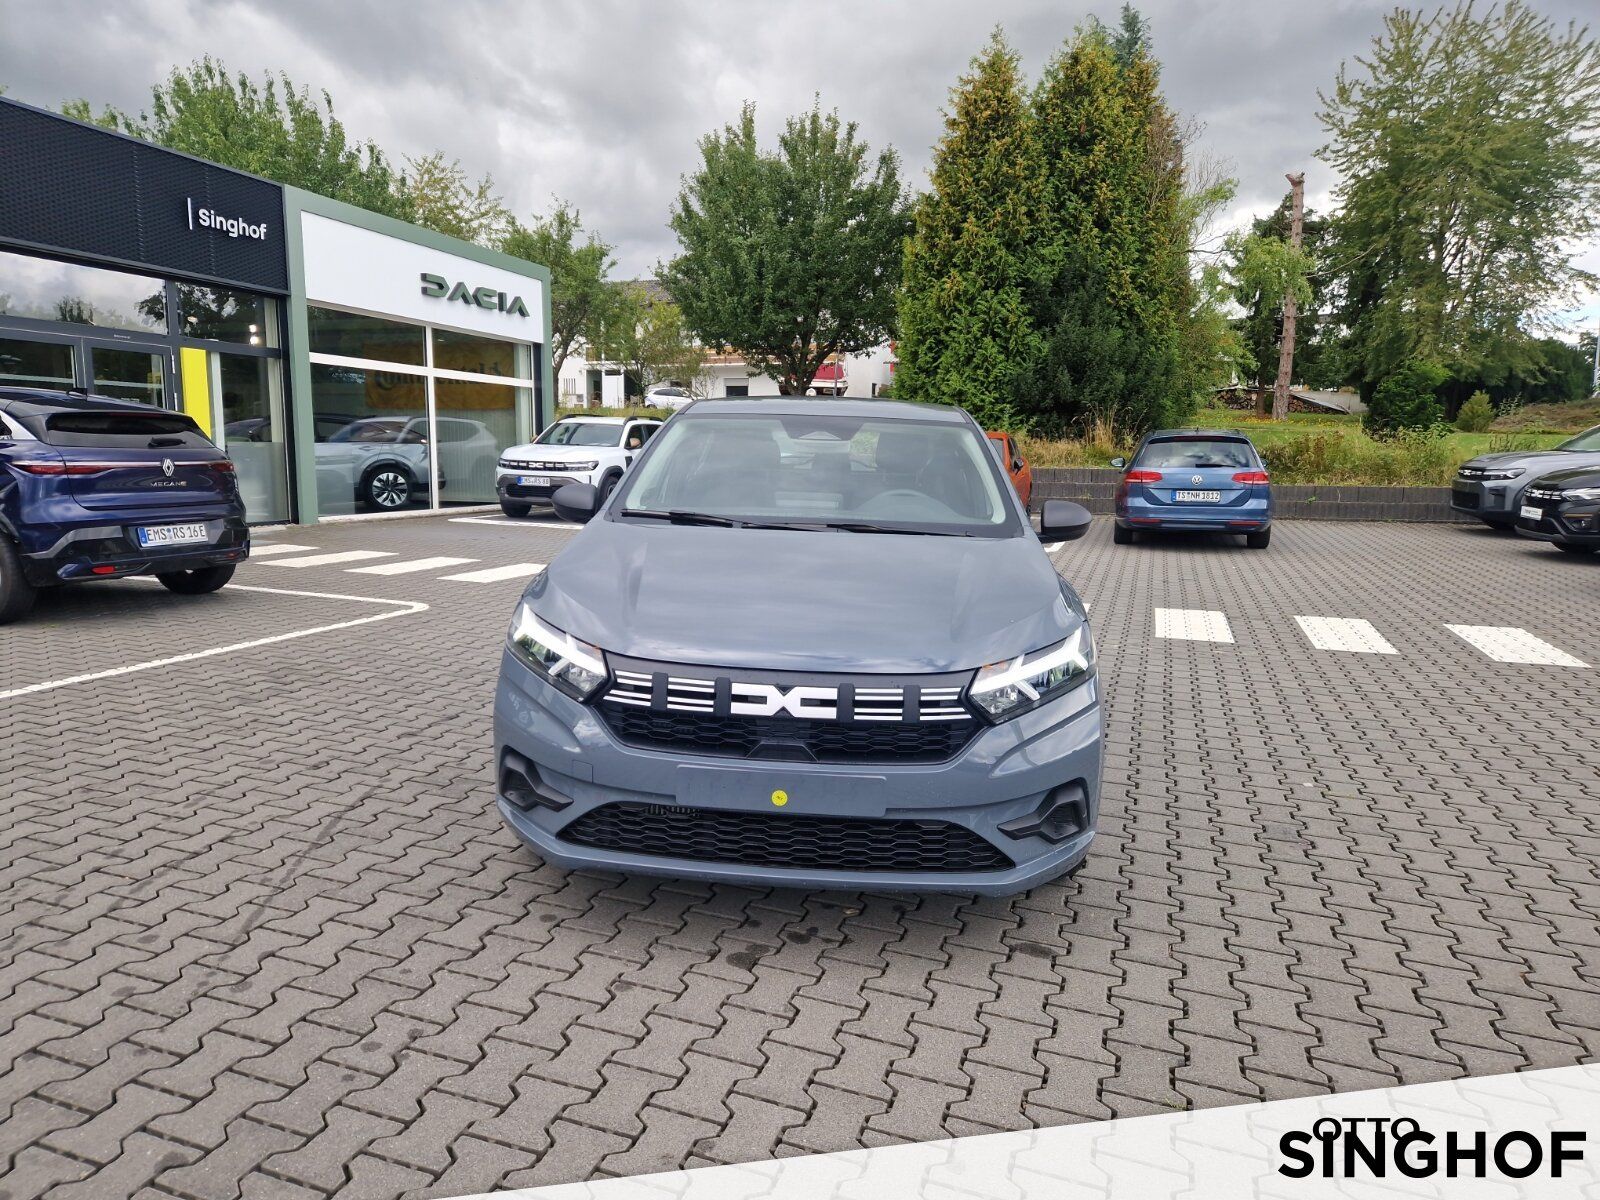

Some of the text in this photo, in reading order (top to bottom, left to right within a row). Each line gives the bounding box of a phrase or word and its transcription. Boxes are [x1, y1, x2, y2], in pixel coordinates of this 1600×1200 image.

[198, 208, 267, 240] Singhof
[420, 273, 530, 318] DACIA
[1177, 491, 1186, 499] TS
[1190, 491, 1201, 500] NH
[146, 528, 167, 542] EMS
[172, 526, 186, 540] RS
